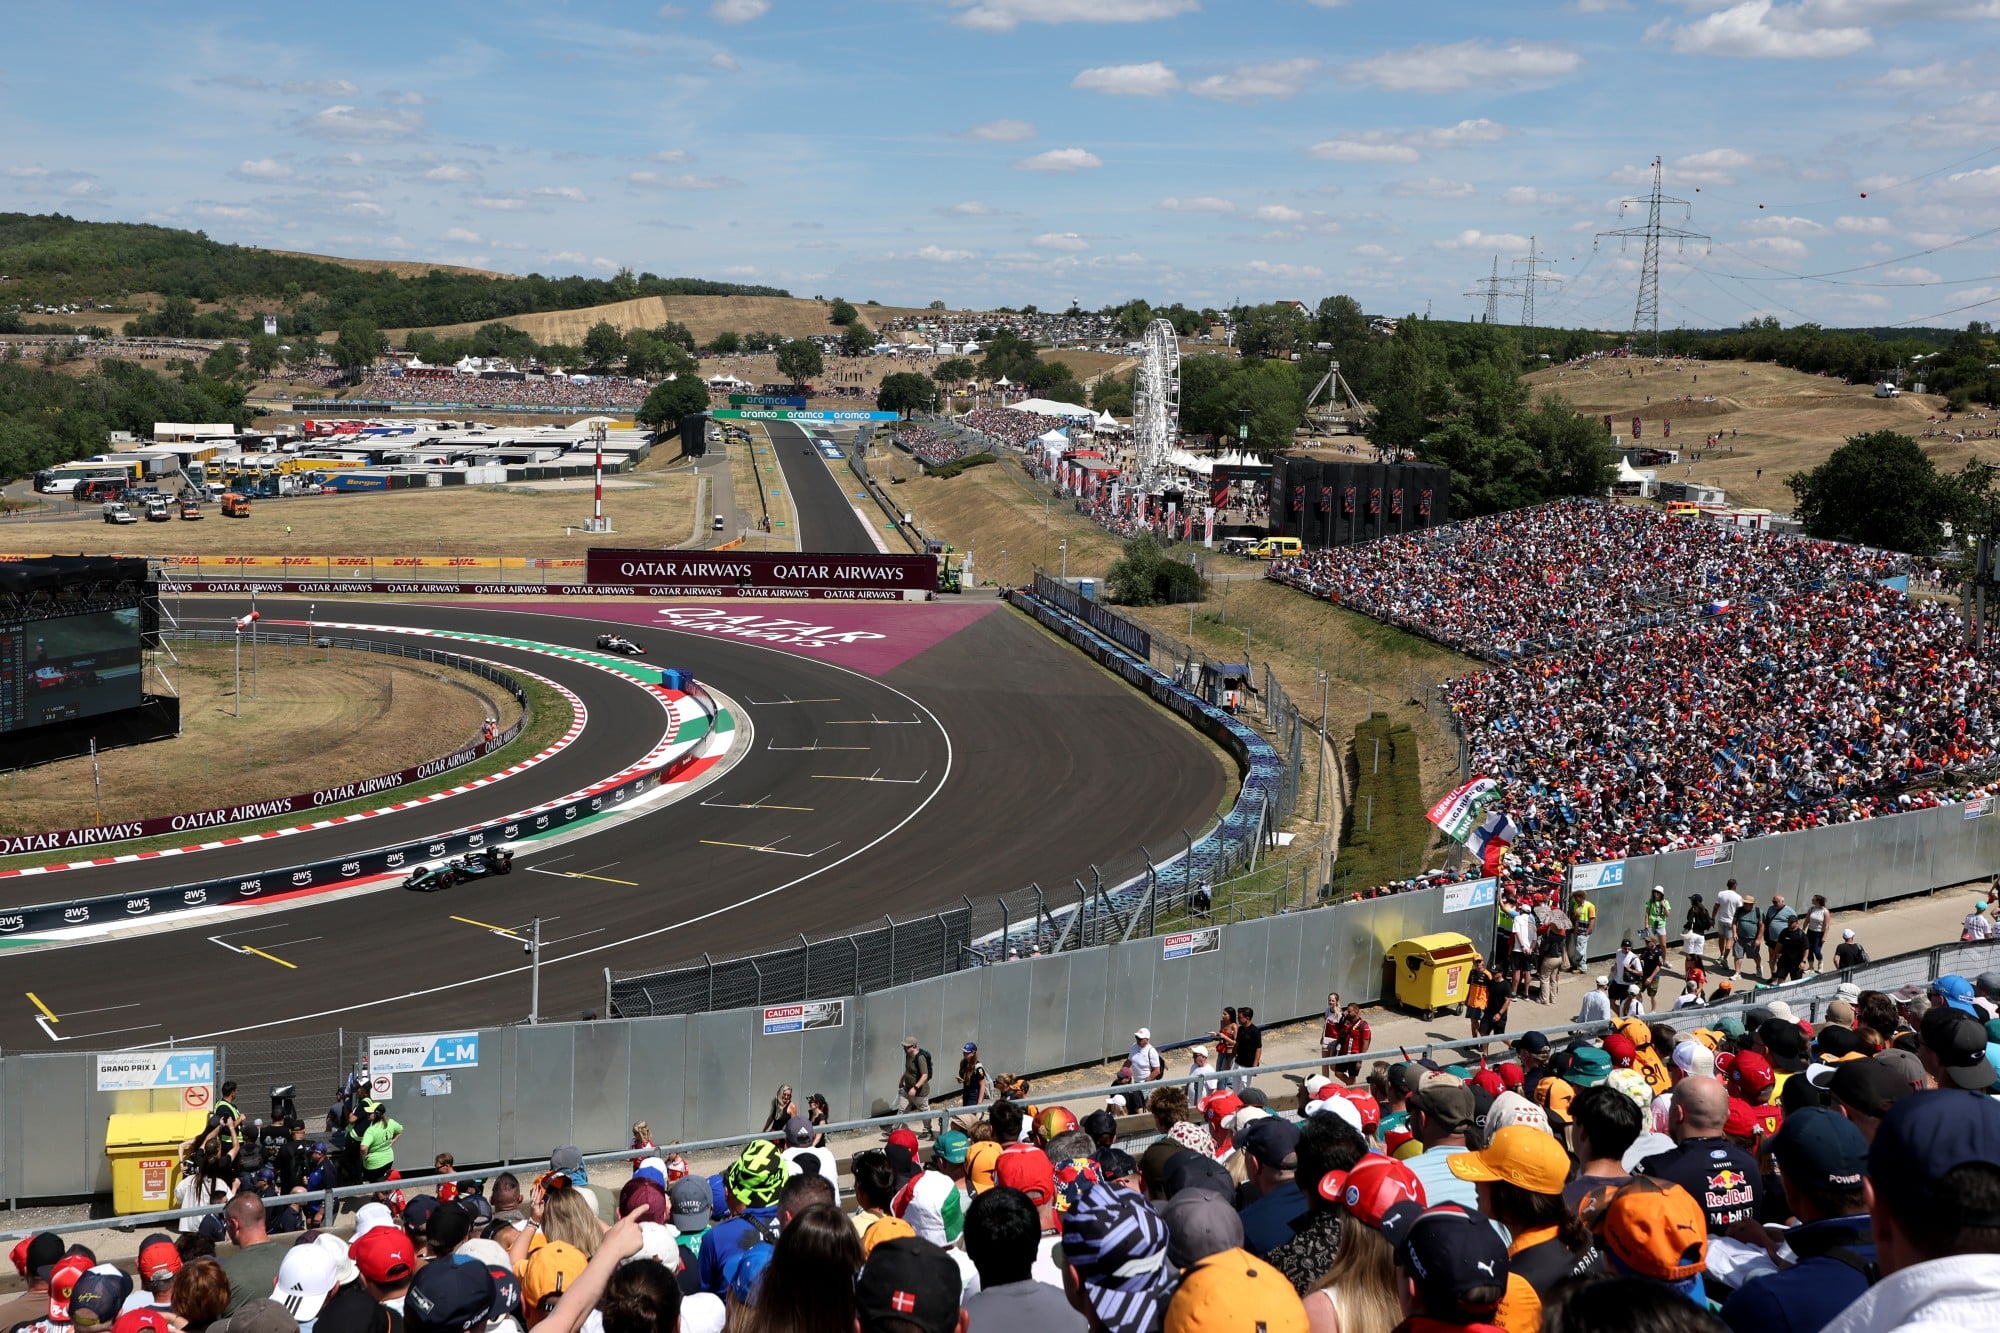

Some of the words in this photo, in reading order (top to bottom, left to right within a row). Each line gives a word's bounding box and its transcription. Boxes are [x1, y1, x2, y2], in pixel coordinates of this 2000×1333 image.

[746, 396, 787, 405] aramco
[740, 410, 778, 418] aramco
[787, 410, 824, 419] aramco
[833, 411, 871, 419] aramco
[346, 479, 382, 487] Berger
[224, 557, 257, 565] DHL
[281, 557, 313, 565] DHL
[336, 558, 369, 566] DHL
[392, 558, 425, 566] DHL
[447, 558, 477, 566] DHL
[620, 562, 676, 578] QATAR
[681, 562, 752, 578] AIRWAYS
[773, 564, 830, 580] QATAR
[833, 565, 905, 581] AIRWAYS
[158, 583, 193, 592] IRWAYS
[208, 584, 241, 592] QATAR
[243, 584, 283, 592] AIRWAYS
[298, 584, 331, 592] QATAR
[334, 584, 373, 592] AIRWAYS
[387, 584, 419, 593] QATAR
[421, 584, 460, 593] AIRWAYS
[475, 585, 506, 594] QATAR
[509, 585, 548, 594] AIRWAYS
[562, 585, 595, 595] QATAR
[596, 586, 635, 595] AIRWAYS
[649, 587, 682, 597] QATAR
[684, 587, 722, 597] AIRWAYS
[736, 588, 769, 598] QATAR
[772, 588, 810, 598] AIRWAYS
[823, 589, 856, 600] QATAR
[858, 590, 896, 600] AIRWAYS
[1037, 575, 1055, 603] QATAR
[1056, 586, 1080, 615] AIRWAYS
[658, 607, 887, 643] QATAR
[1089, 604, 1112, 636] QATAR
[1112, 616, 1144, 653] AIRWAYS
[652, 619, 839, 648] AIRWAYS
[1106, 653, 1123, 671] QATAR
[1123, 662, 1143, 687] AIRWAYS
[1151, 681, 1169, 704] QATAR
[1168, 692, 1193, 720] AIRWAYS
[417, 757, 446, 780] QATAR
[447, 748, 476, 771] AIRWAYS
[313, 785, 354, 806] QATAR
[356, 772, 403, 797] AIRWAYS
[1476, 782, 1486, 793] GP
[1432, 785, 1467, 819] FORMULA
[171, 810, 227, 831] QATAR
[230, 797, 292, 824] AIRWAYS
[566, 806, 577, 817] aws
[536, 815, 549, 826] aws
[505, 824, 519, 836] aws
[0, 832, 64, 855] QATAR
[65, 822, 143, 850] AIRWAYS
[469, 832, 484, 843] aws
[429, 842, 446, 854] aws
[387, 852, 404, 865] aws
[341, 861, 360, 874] aws
[292, 870, 313, 884] aws
[1602, 868, 1623, 883] A-B
[240, 879, 262, 893] aws
[184, 888, 206, 903] aws
[1474, 887, 1494, 901] A-B
[127, 897, 150, 911] aws
[65, 905, 89, 920] aws
[0, 914, 23, 929] aws
[1166, 936, 1191, 945] CAUTION
[767, 1008, 801, 1018] CAUTION
[373, 1048, 401, 1056] GRAND
[434, 1043, 475, 1063] L-M
[101, 1065, 130, 1073] GRAND
[131, 1064, 150, 1072] PRIX
[166, 1062, 211, 1081] L-M
[1828, 1173, 1861, 1185] POWER
[1705, 1189, 1732, 1208] Red
[1731, 1185, 1754, 1205] Bull
[1710, 1208, 1742, 1225] Mobil
[1571, 1246, 1598, 1278] ORRIS
